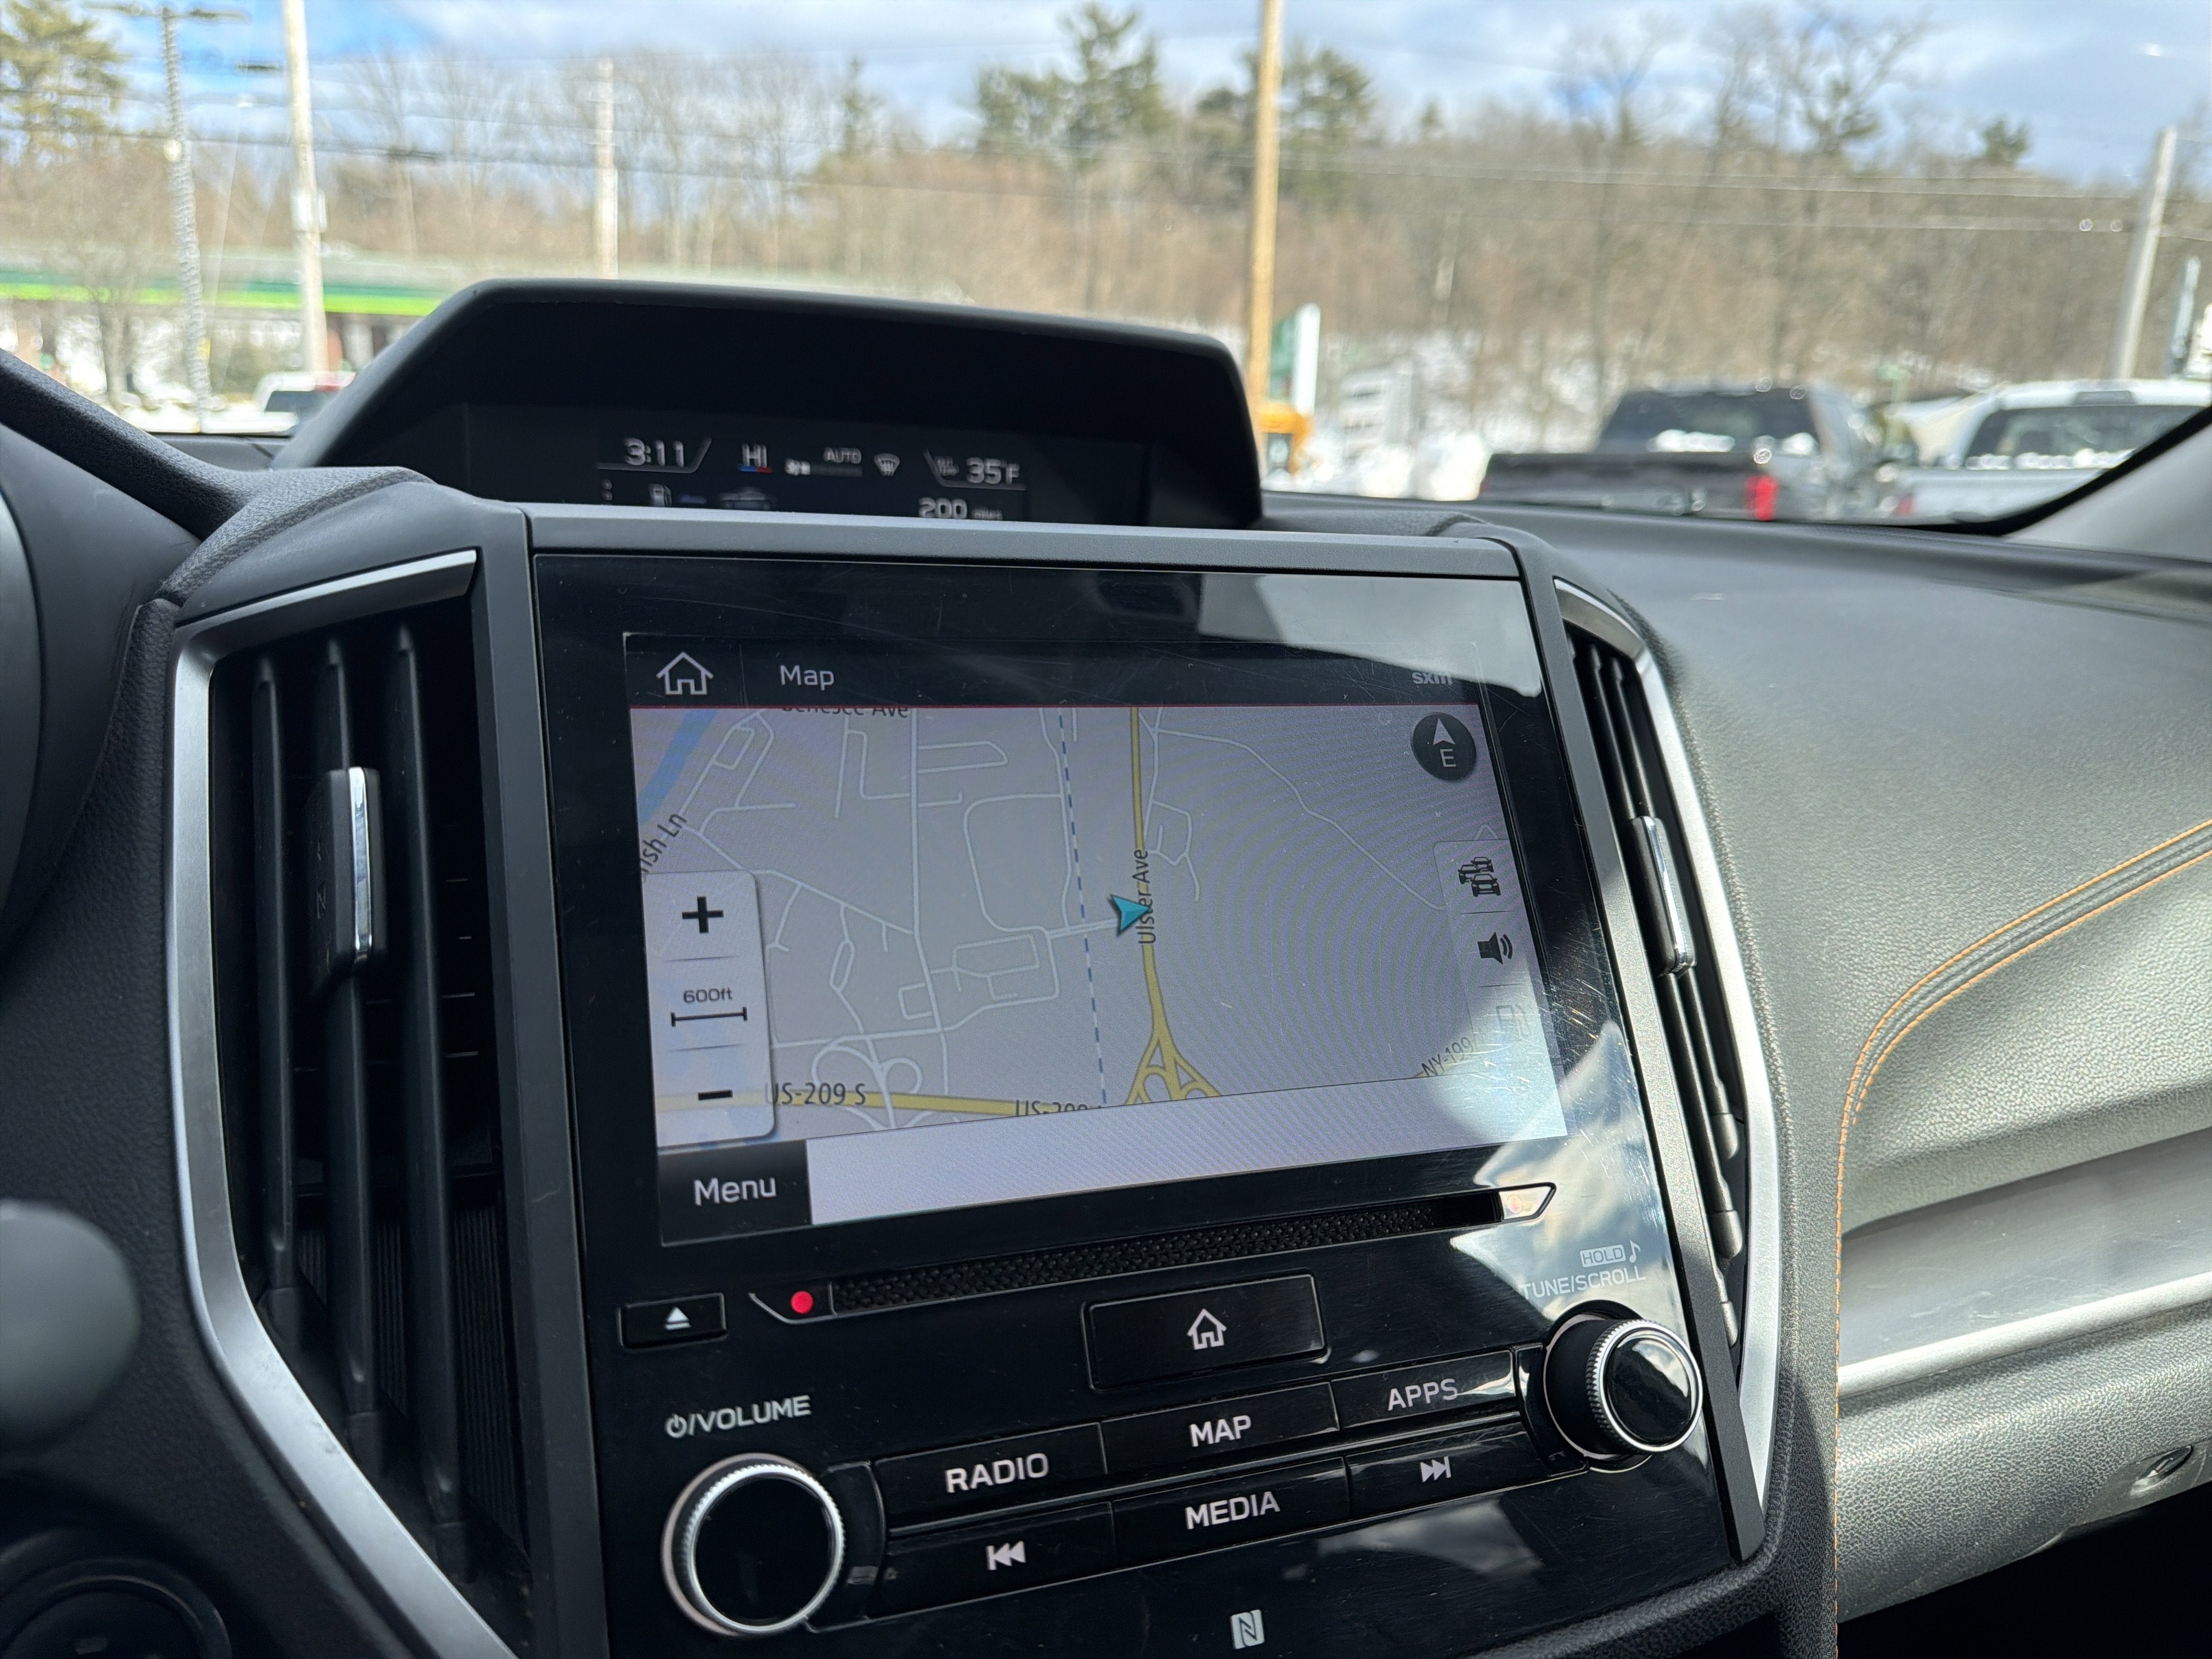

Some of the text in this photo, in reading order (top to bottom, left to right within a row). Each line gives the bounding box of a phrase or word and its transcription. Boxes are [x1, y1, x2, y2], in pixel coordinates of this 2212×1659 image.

[624, 437, 685, 467] 3:11
[741, 443, 767, 467] HI
[823, 447, 862, 464] AUTO
[918, 496, 968, 519] 200
[780, 664, 834, 691] Map
[1440, 748, 1457, 768] E
[657, 814, 687, 837] Ln
[1132, 849, 1156, 944] Ulser Ave
[682, 987, 733, 1005] 600ft
[854, 1082, 866, 1105] S
[694, 1177, 776, 1206] Menu
[1582, 1246, 1624, 1266] HOLD
[1518, 1265, 1646, 1300] TUNE/SCROLL
[1387, 1378, 1458, 1411] APPS
[1189, 1415, 1252, 1447] MAP
[945, 1453, 1048, 1493] RADIO
[1185, 1491, 1281, 1530] MEDIA
